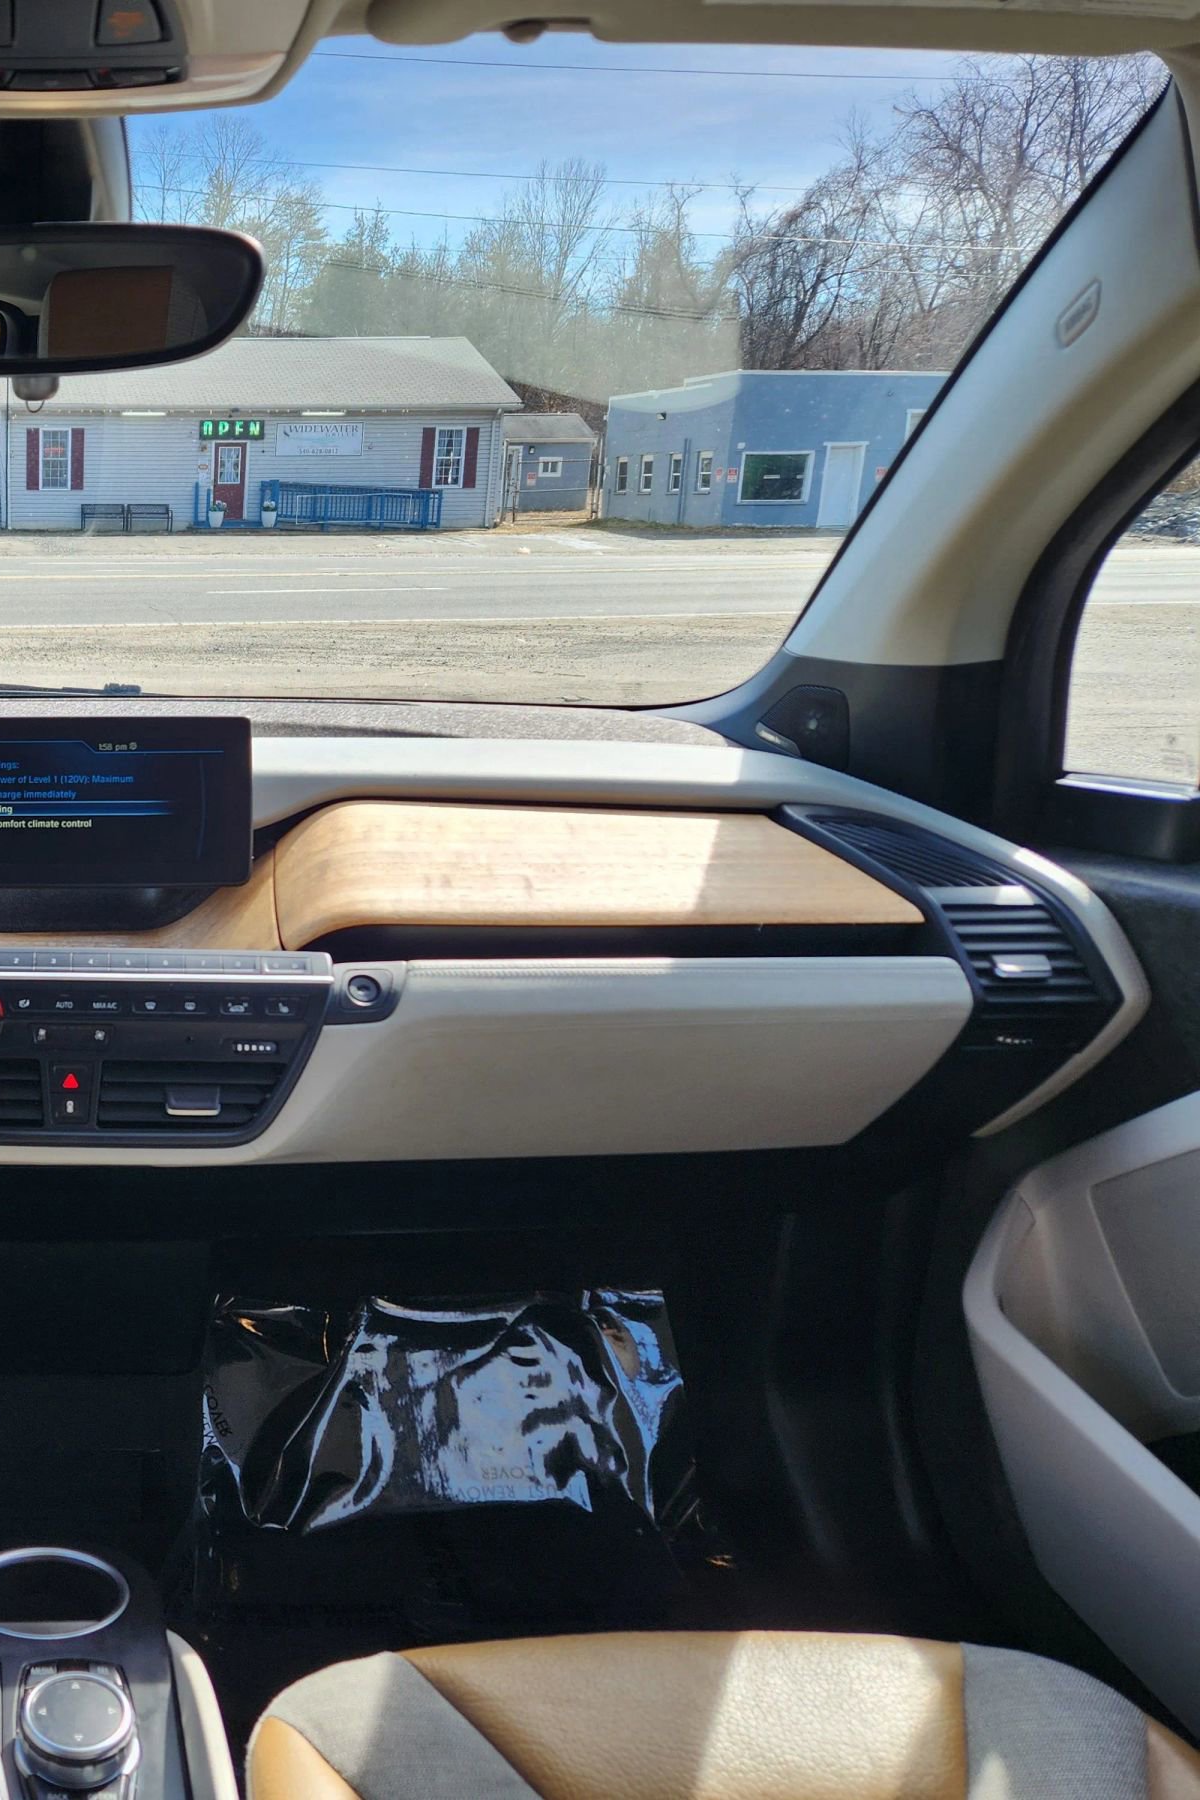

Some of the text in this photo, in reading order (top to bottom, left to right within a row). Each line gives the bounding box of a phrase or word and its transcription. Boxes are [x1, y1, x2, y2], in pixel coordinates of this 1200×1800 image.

[289, 424, 359, 433] WIDEWATER
[115, 743, 128, 752] pm
[17, 775, 27, 783] of
[92, 775, 134, 783] Maximum
[23, 790, 76, 799] immediately
[27, 819, 60, 828] climate
[61, 819, 92, 828] control
[56, 1001, 74, 1009] AUTO
